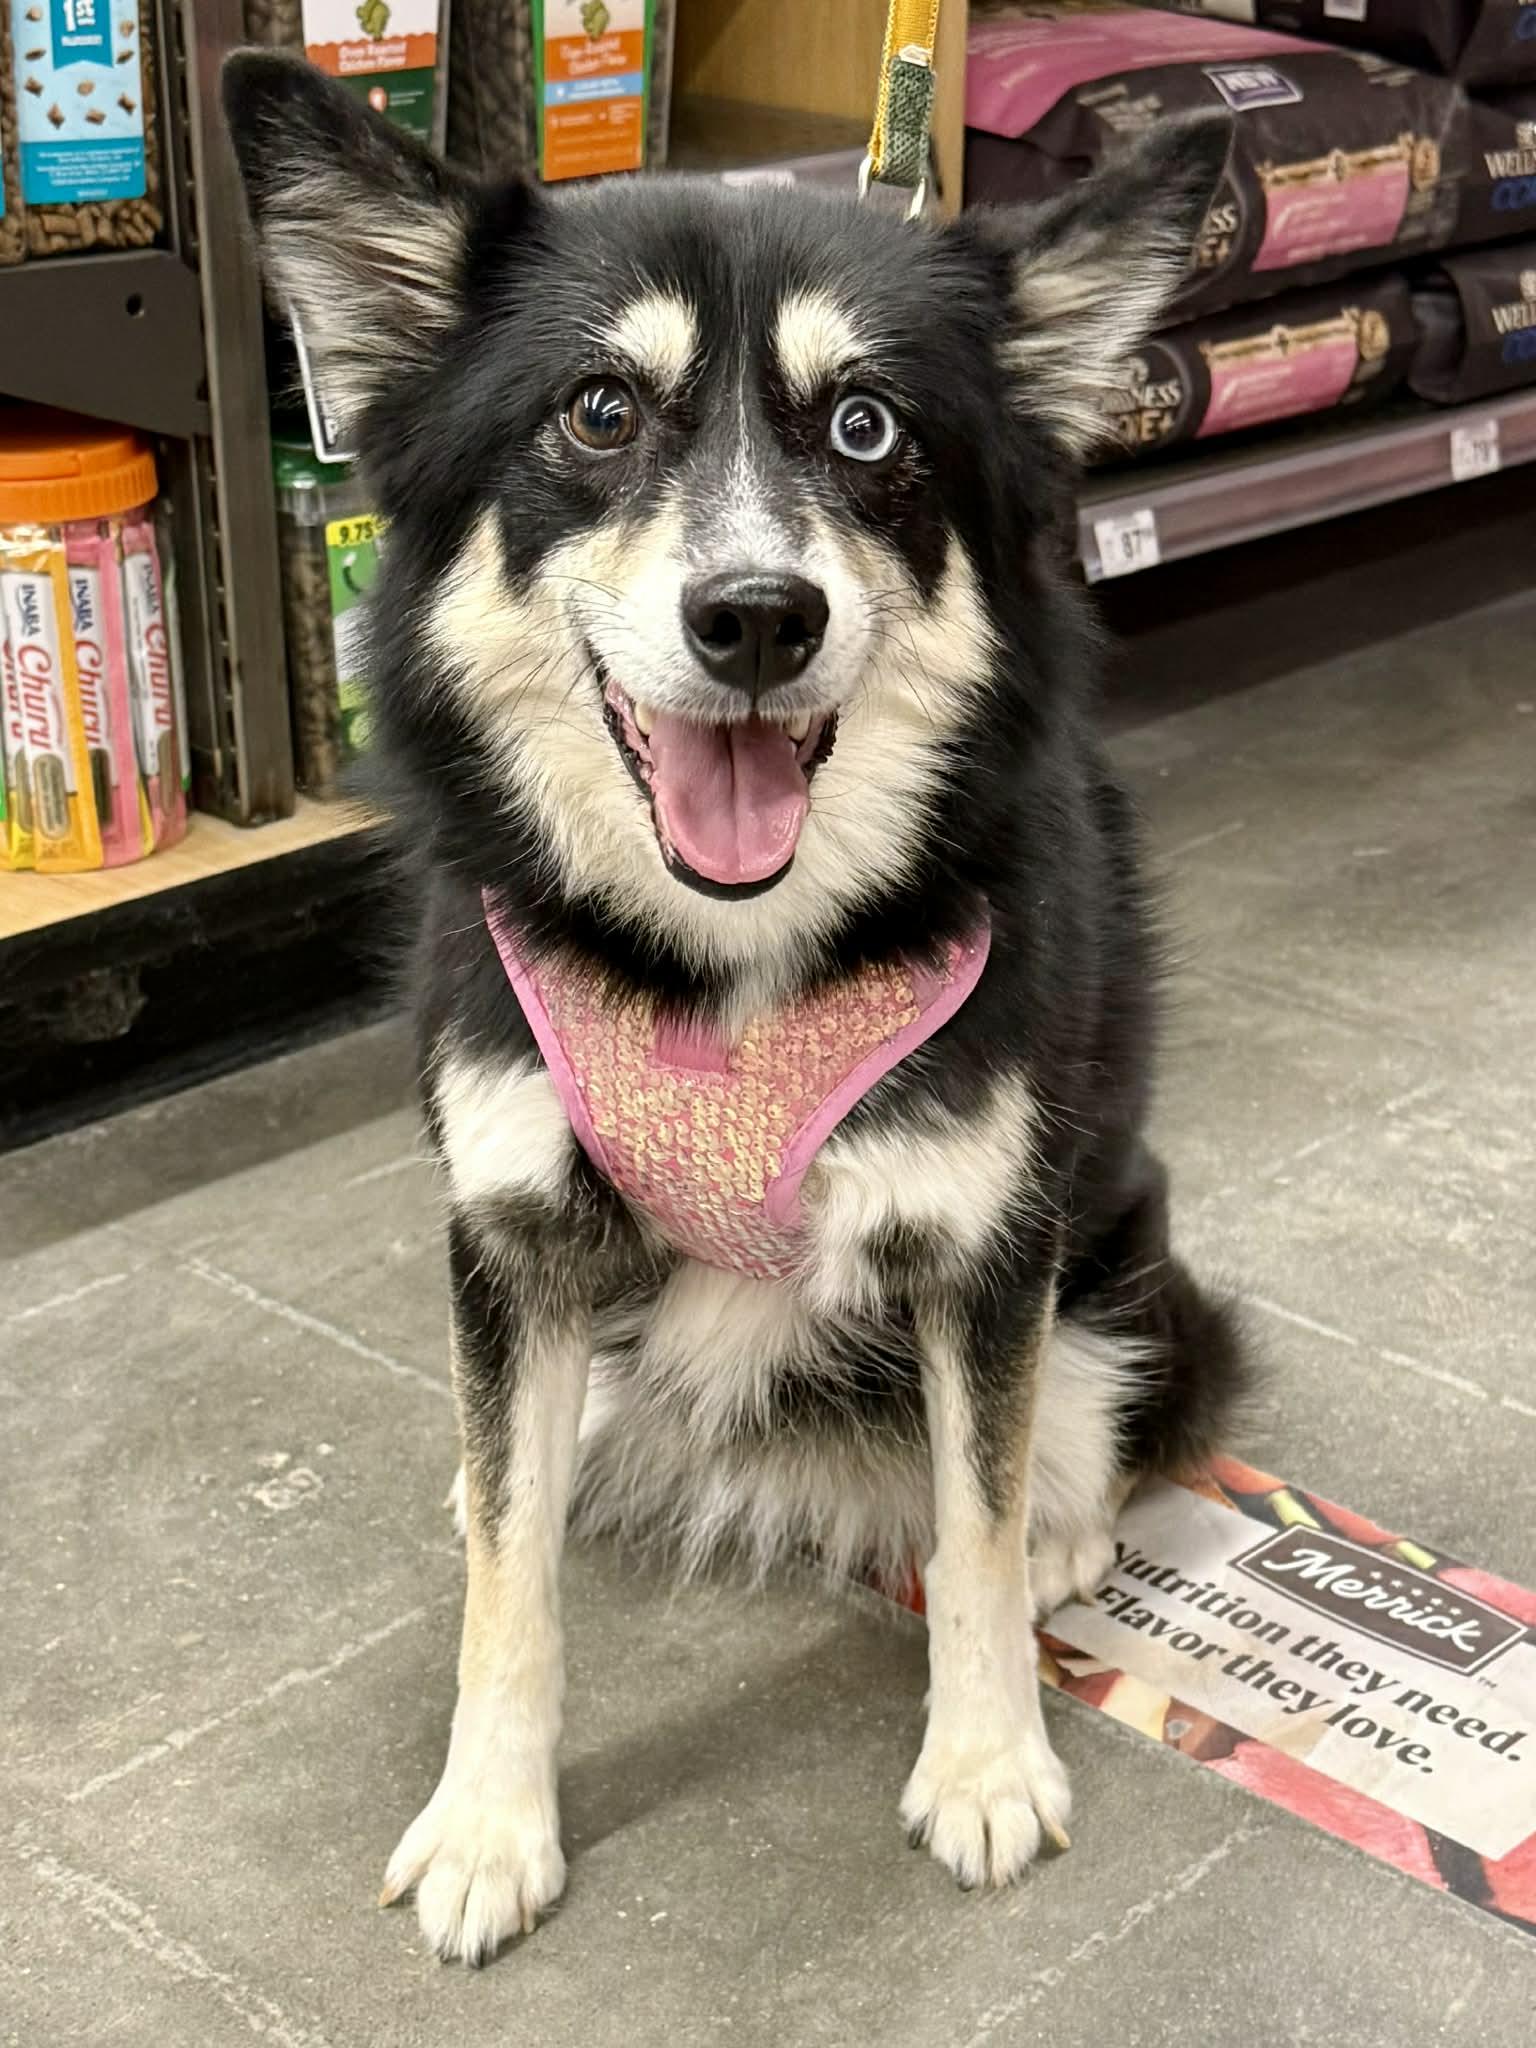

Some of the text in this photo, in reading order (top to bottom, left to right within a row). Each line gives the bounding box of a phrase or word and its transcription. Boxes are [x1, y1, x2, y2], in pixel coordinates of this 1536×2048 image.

[1219, 71, 1279, 92] NEW
[22, 583, 41, 637] INABA
[75, 579, 94, 632] INABA
[18, 644, 52, 750] Churu
[76, 639, 102, 745] Churu
[145, 623, 172, 726] Churu
[1261, 1548, 1482, 1653] Merrick
[1095, 1585, 1434, 1774] Flavor they love.
[1290, 1634, 1401, 1695] they
[1393, 1689, 1528, 1762] need.
